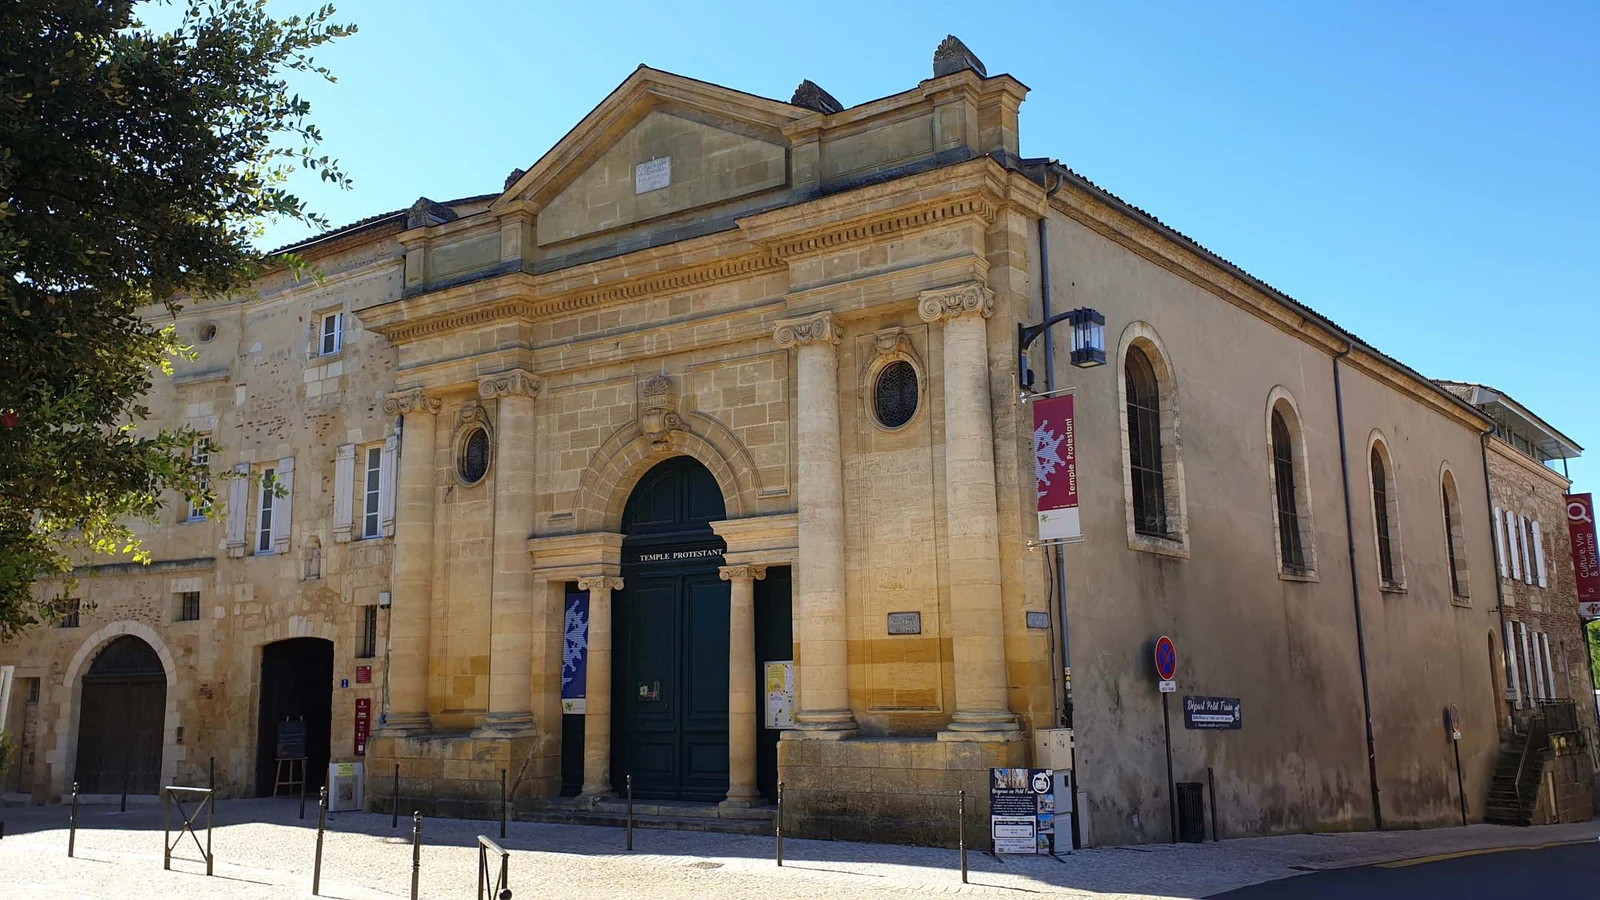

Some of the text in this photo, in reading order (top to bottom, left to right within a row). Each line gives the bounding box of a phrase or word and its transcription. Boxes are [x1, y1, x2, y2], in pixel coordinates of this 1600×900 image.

[1065, 418, 1076, 496] Temple Protestant
[1576, 533, 1585, 547] Vin
[640, 548, 723, 562] TEMPLE PROTESTANT
[1586, 532, 1597, 569] Tourisme
[1187, 699, 1233, 713] Départ Petit Train
